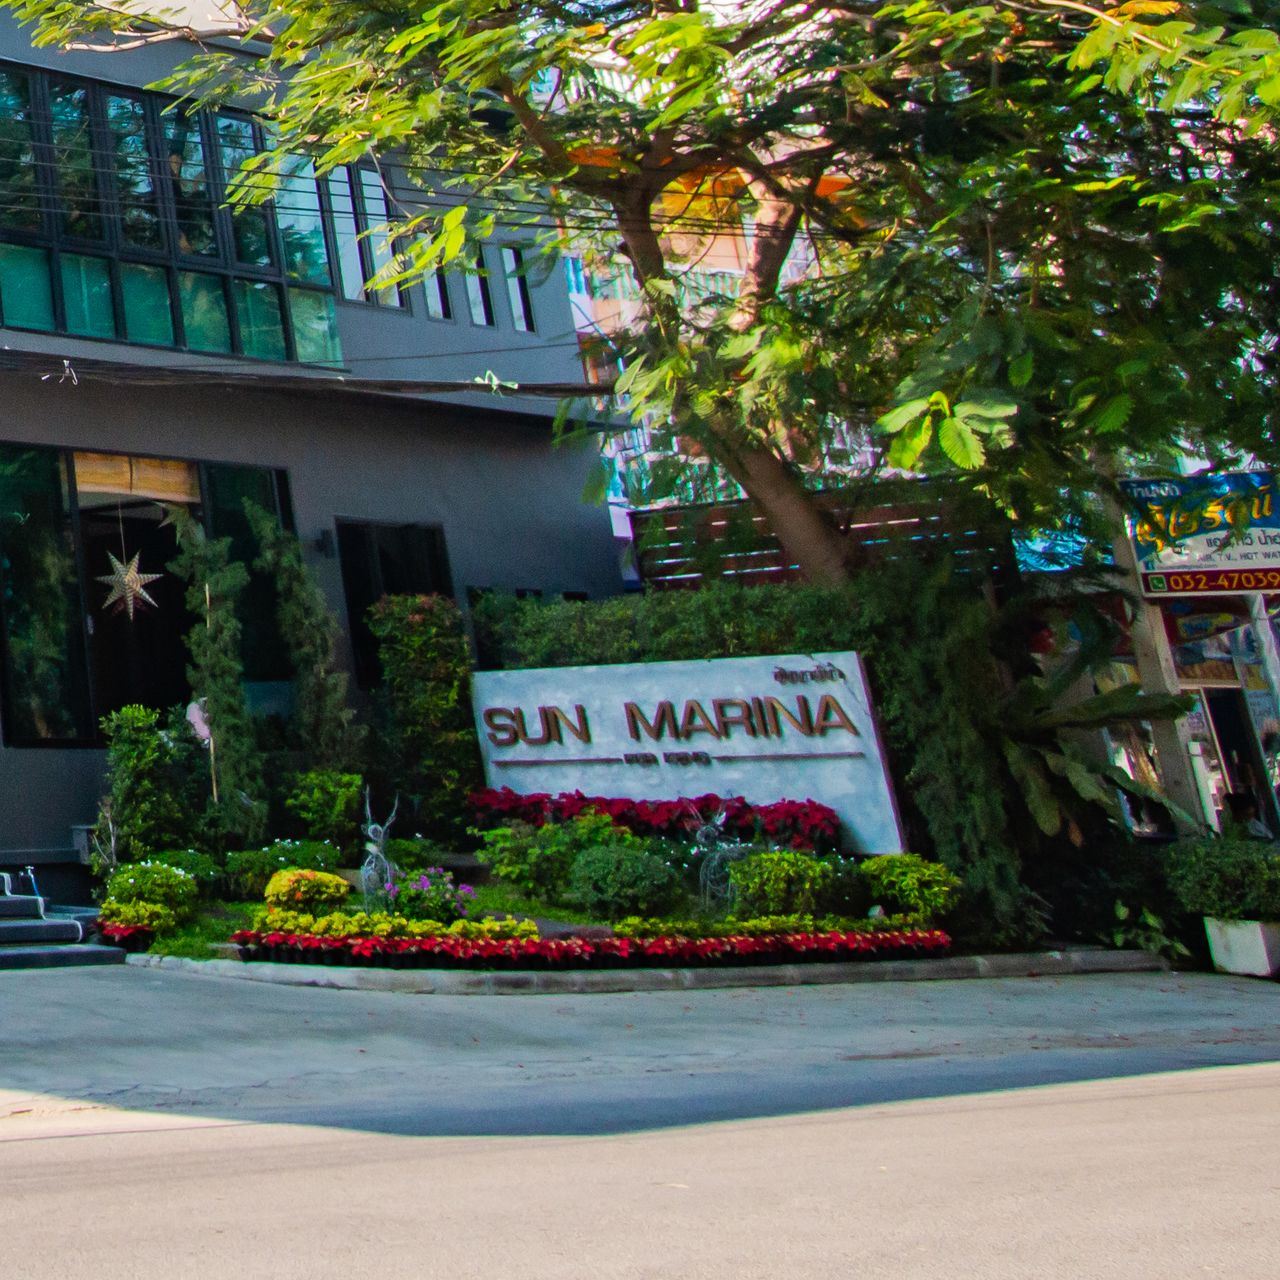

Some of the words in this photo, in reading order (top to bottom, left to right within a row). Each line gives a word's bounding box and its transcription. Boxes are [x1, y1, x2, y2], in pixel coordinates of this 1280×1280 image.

[1240, 551, 1258, 561] HOT
[482, 702, 592, 746] SUN
[624, 694, 861, 742] MARINA
